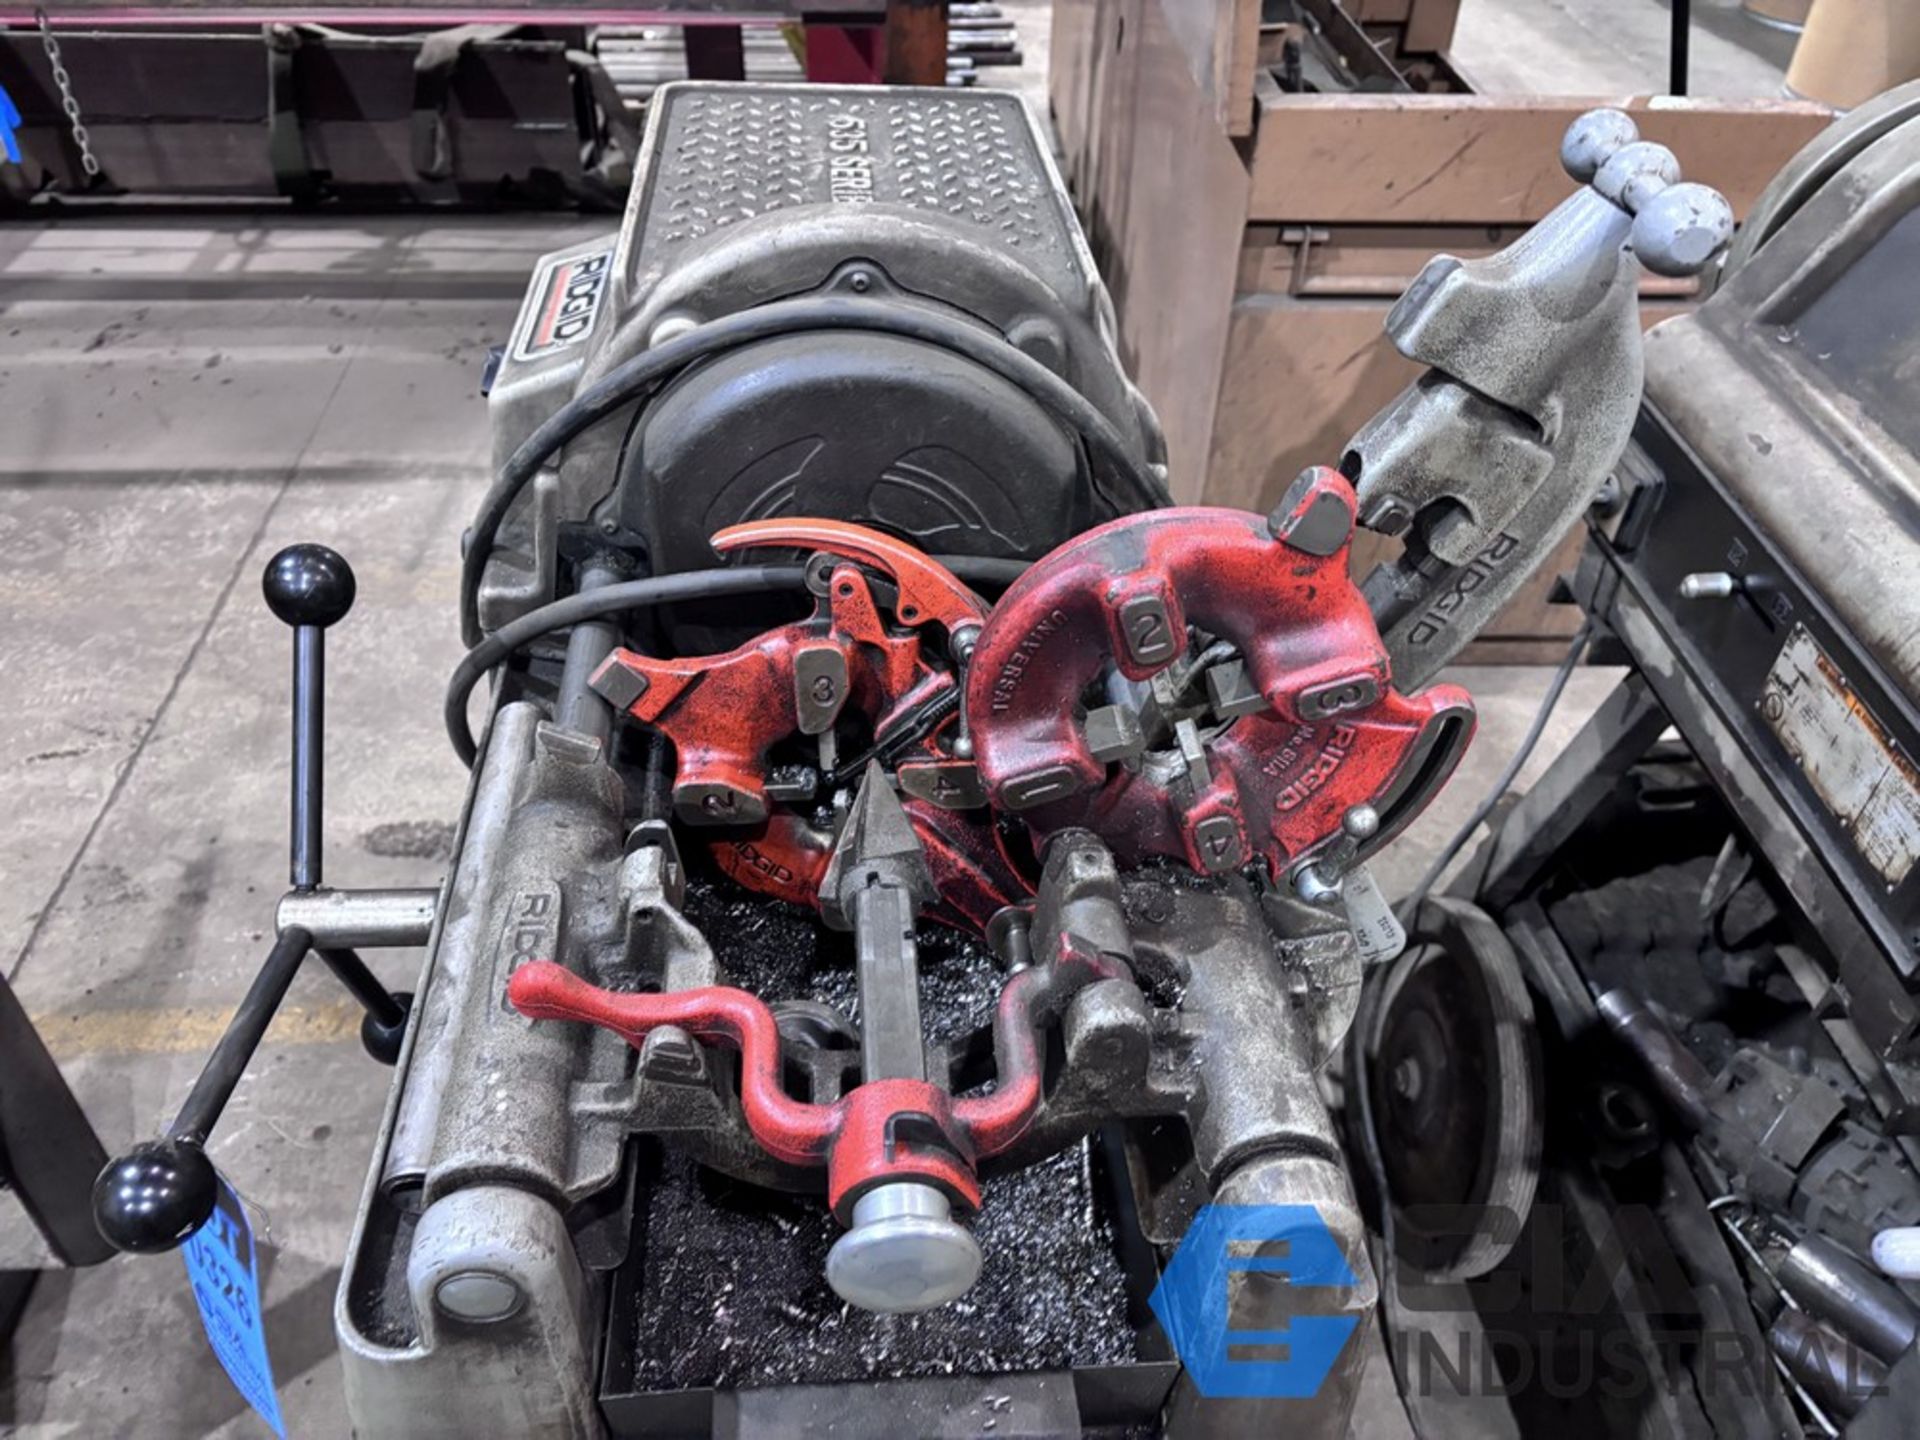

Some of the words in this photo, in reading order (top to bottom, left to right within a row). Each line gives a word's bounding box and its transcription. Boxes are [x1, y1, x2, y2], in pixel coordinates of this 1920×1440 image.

[553, 254, 608, 340] RIDGID
[1408, 531, 1520, 645] RIDGID
[1131, 613, 1168, 655] 2
[811, 674, 836, 708] 3
[1318, 684, 1364, 717] 3
[1275, 724, 1356, 811] RIDGID
[701, 789, 738, 817] 2
[735, 840, 794, 884] IDGID
[1203, 832, 1235, 863] 4
